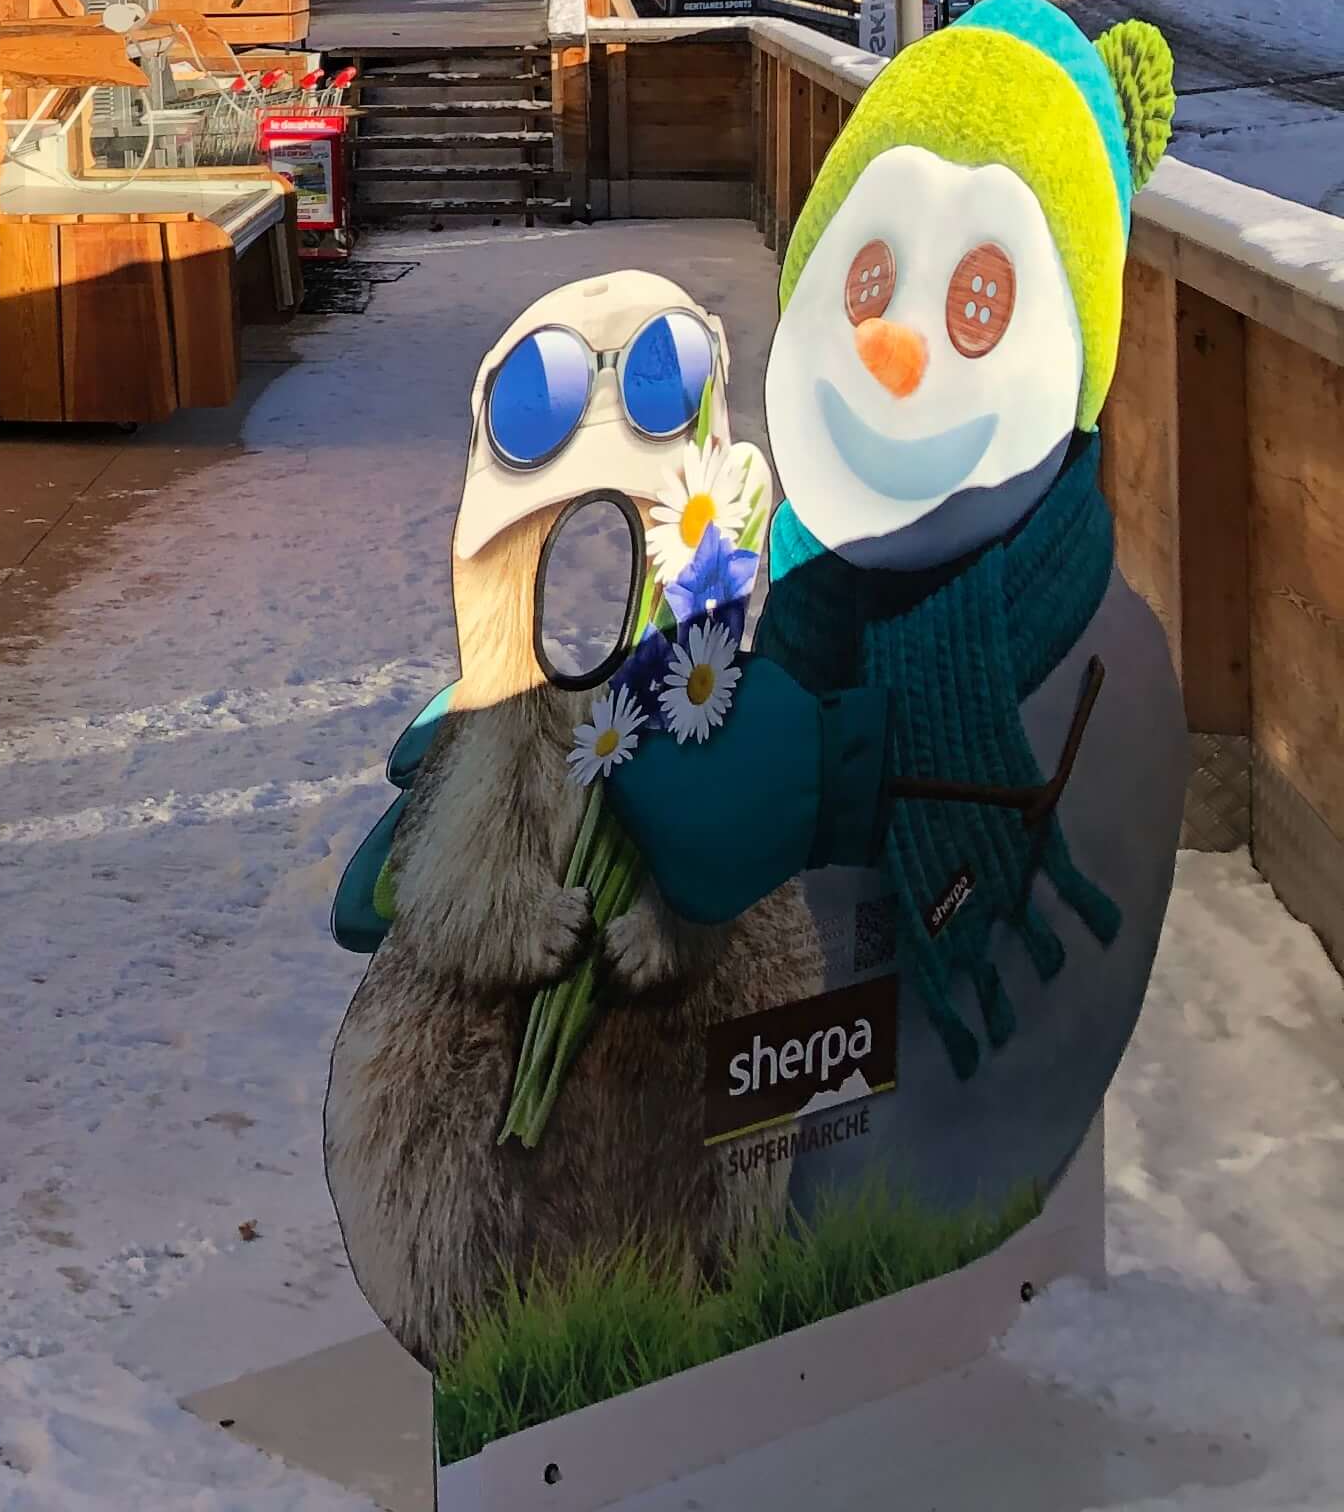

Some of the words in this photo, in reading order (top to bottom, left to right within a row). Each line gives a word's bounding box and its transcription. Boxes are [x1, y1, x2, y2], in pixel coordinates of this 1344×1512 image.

[725, 0, 753, 9] SPORTS
[932, 876, 968, 927] sherpa
[728, 1018, 872, 1097] sherpa
[727, 1105, 871, 1177] SUPERMARCHÉ
